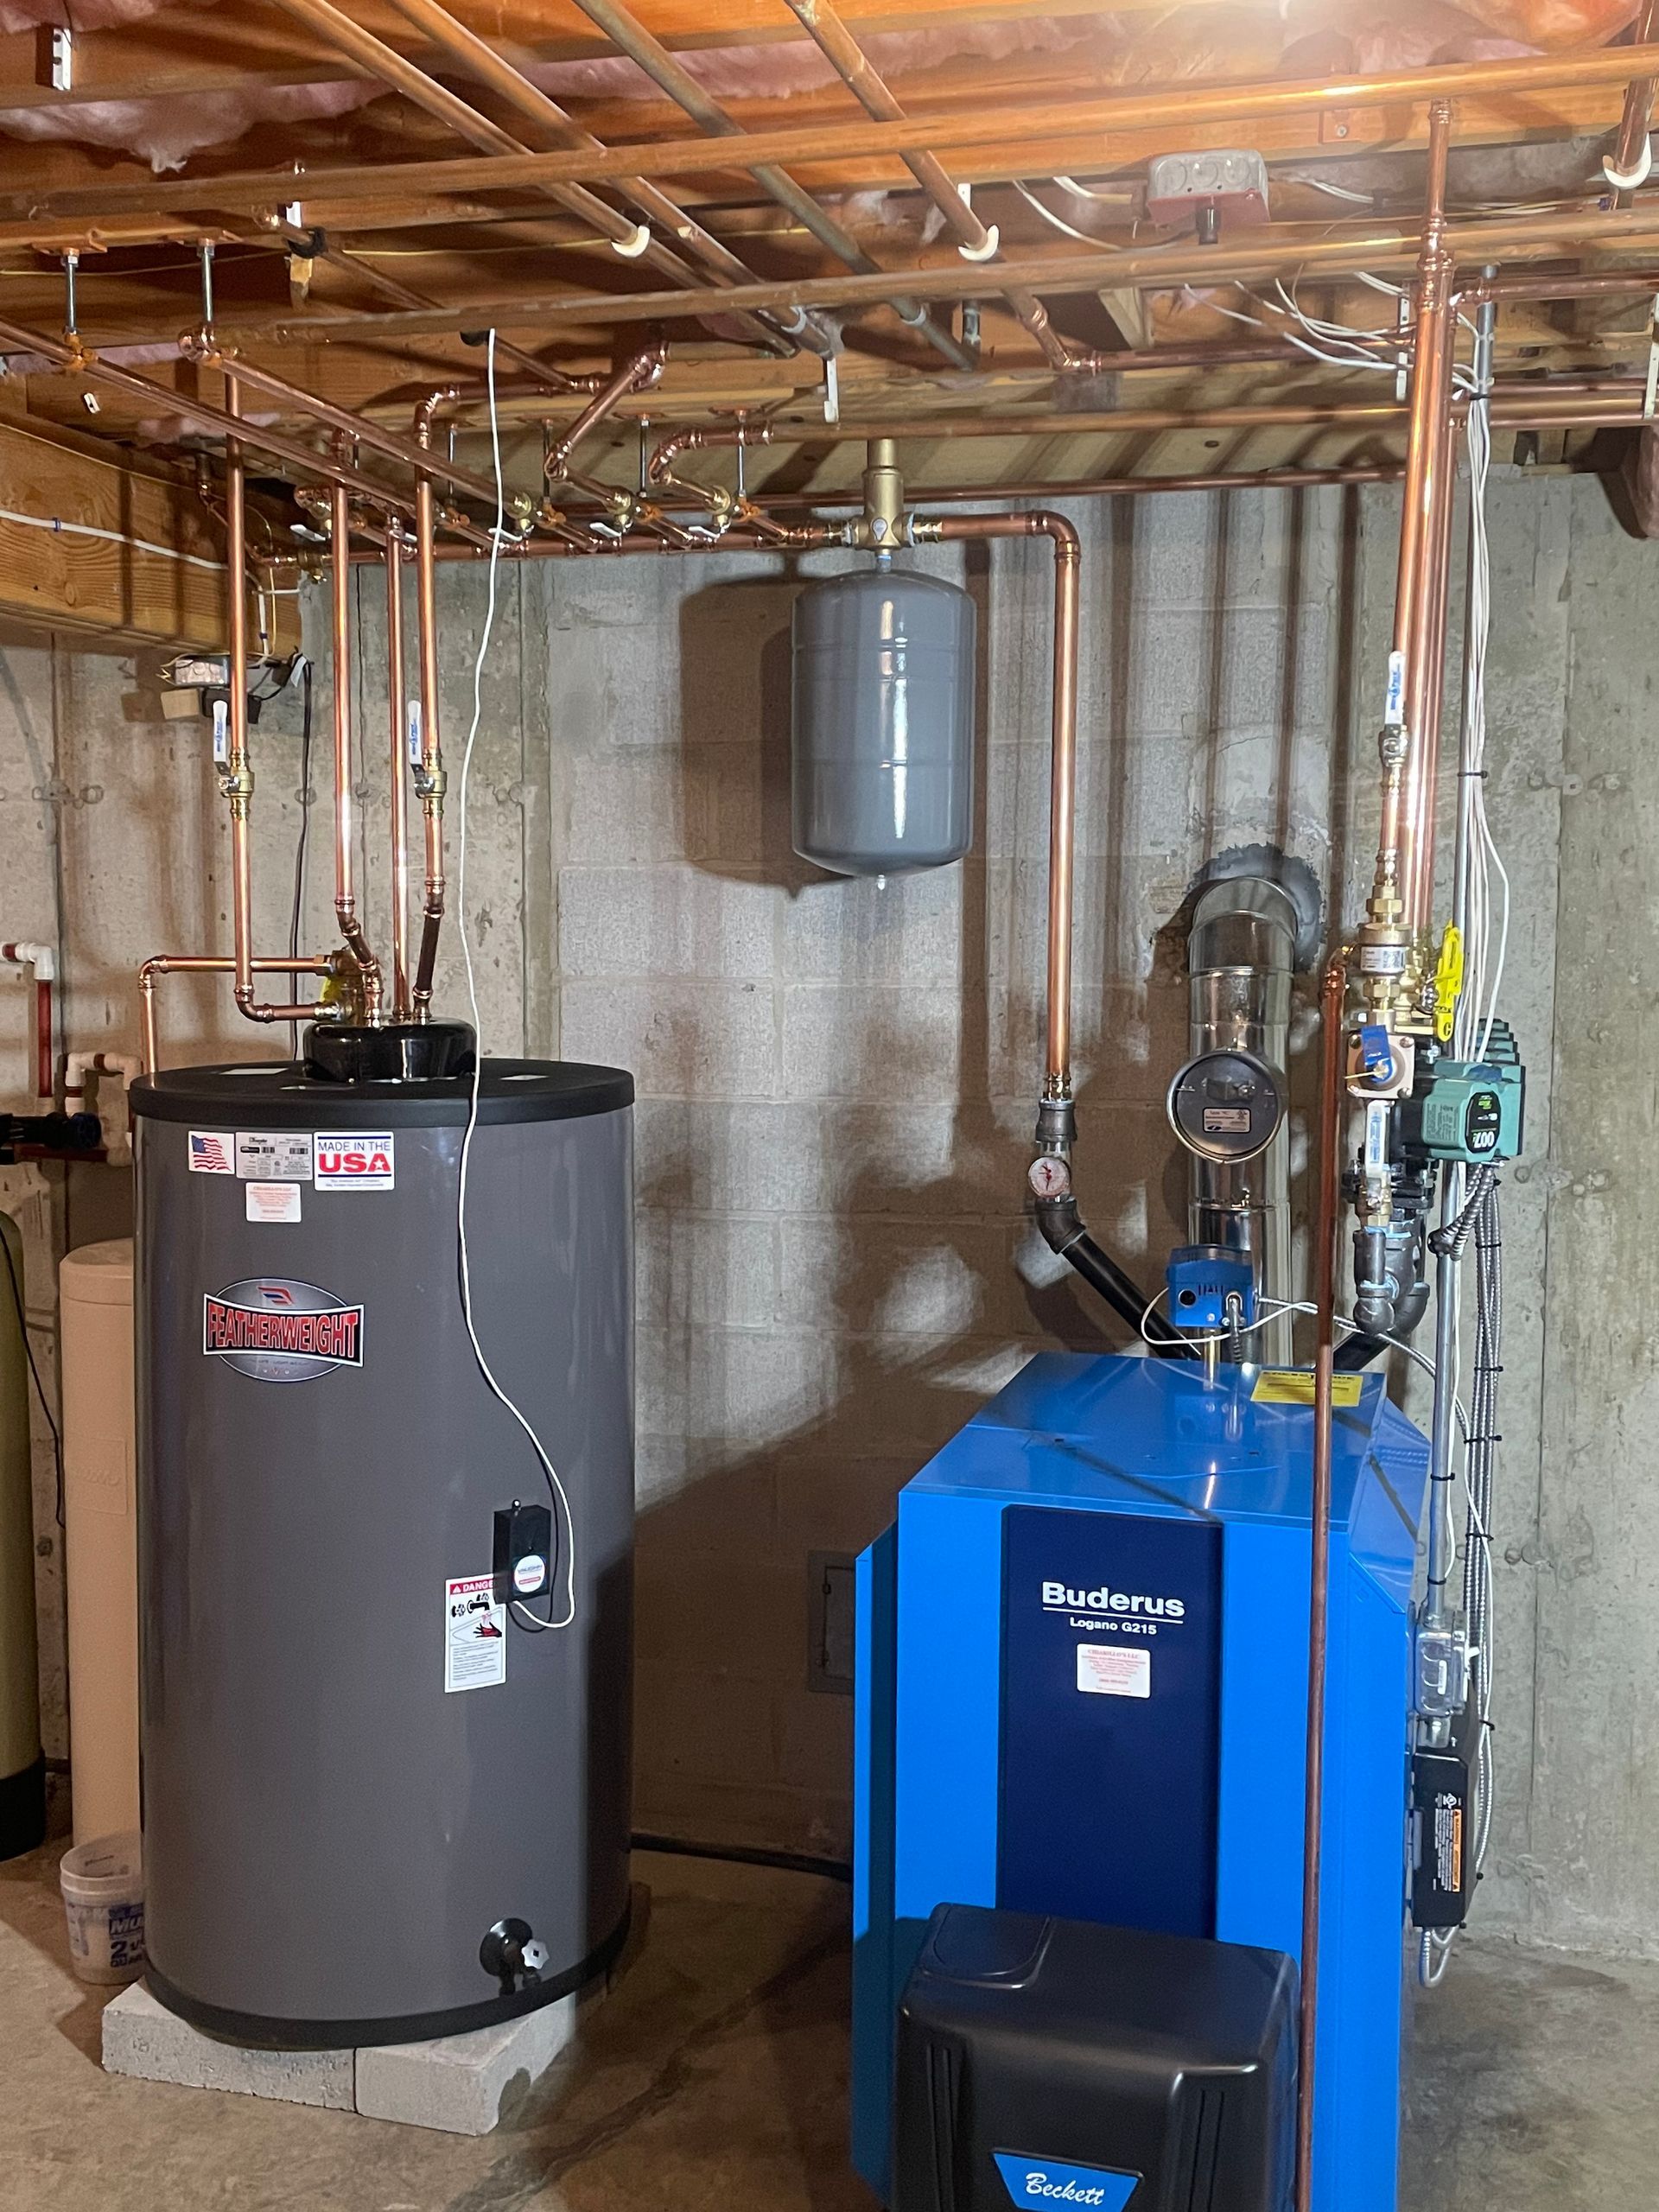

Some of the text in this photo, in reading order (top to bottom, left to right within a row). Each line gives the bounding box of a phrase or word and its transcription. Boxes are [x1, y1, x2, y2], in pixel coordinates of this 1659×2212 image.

[318, 1141, 350, 1152] MADE
[354, 1141, 365, 1151] IN
[368, 1141, 391, 1151] THE
[319, 1153, 391, 1173] USA
[207, 1301, 359, 1358] FEATHERWEIGHT
[462, 1580, 493, 1592] DANGE
[1042, 1581, 1185, 1618] Buderus
[1070, 1617, 1157, 1635] Logano G215
[1025, 2172, 1105, 2206] Beckett
